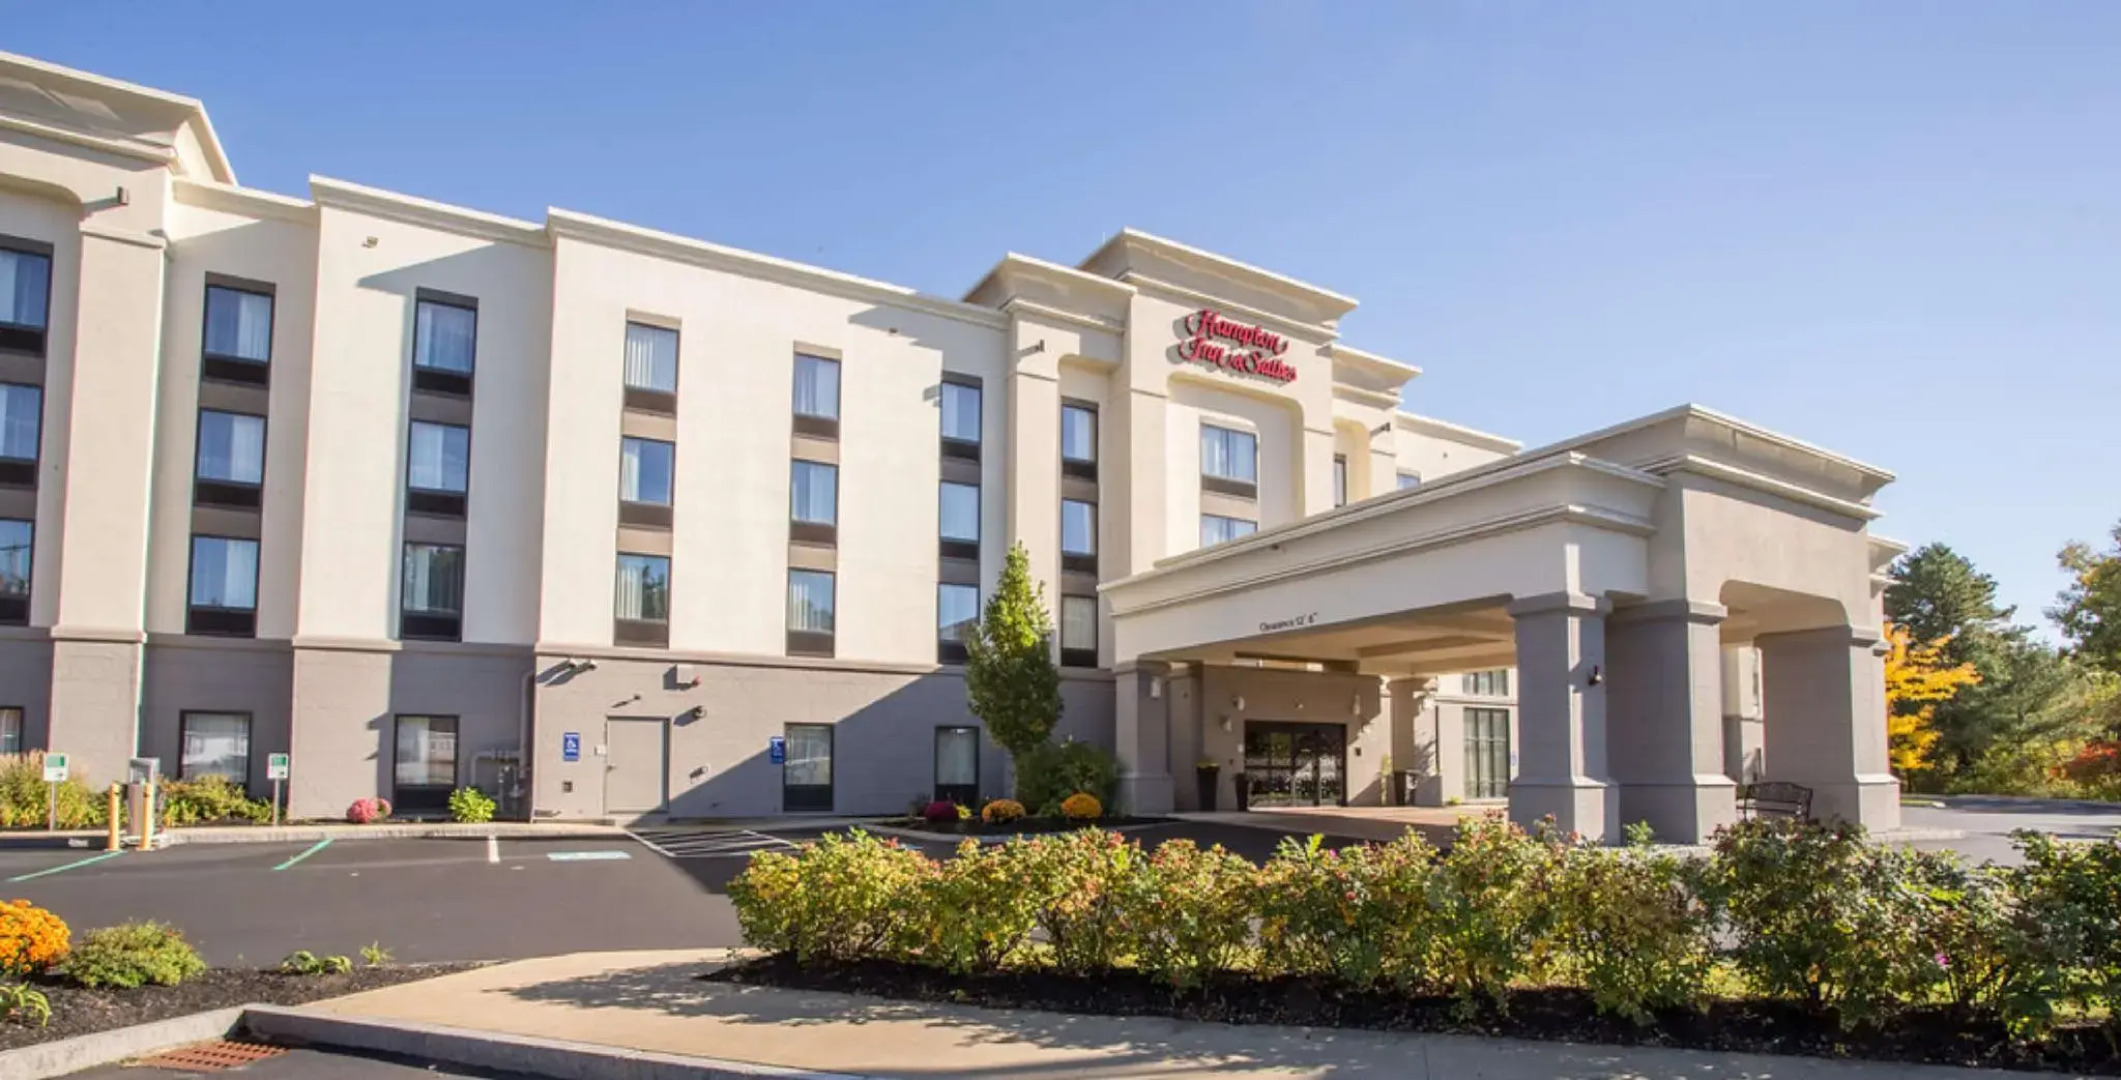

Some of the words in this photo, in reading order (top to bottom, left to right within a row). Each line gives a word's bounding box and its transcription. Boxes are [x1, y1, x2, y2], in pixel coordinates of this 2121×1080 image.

[1186, 308, 1289, 356] Hampton
[1179, 337, 1226, 368] Inn
[1244, 351, 1297, 382] Suites
